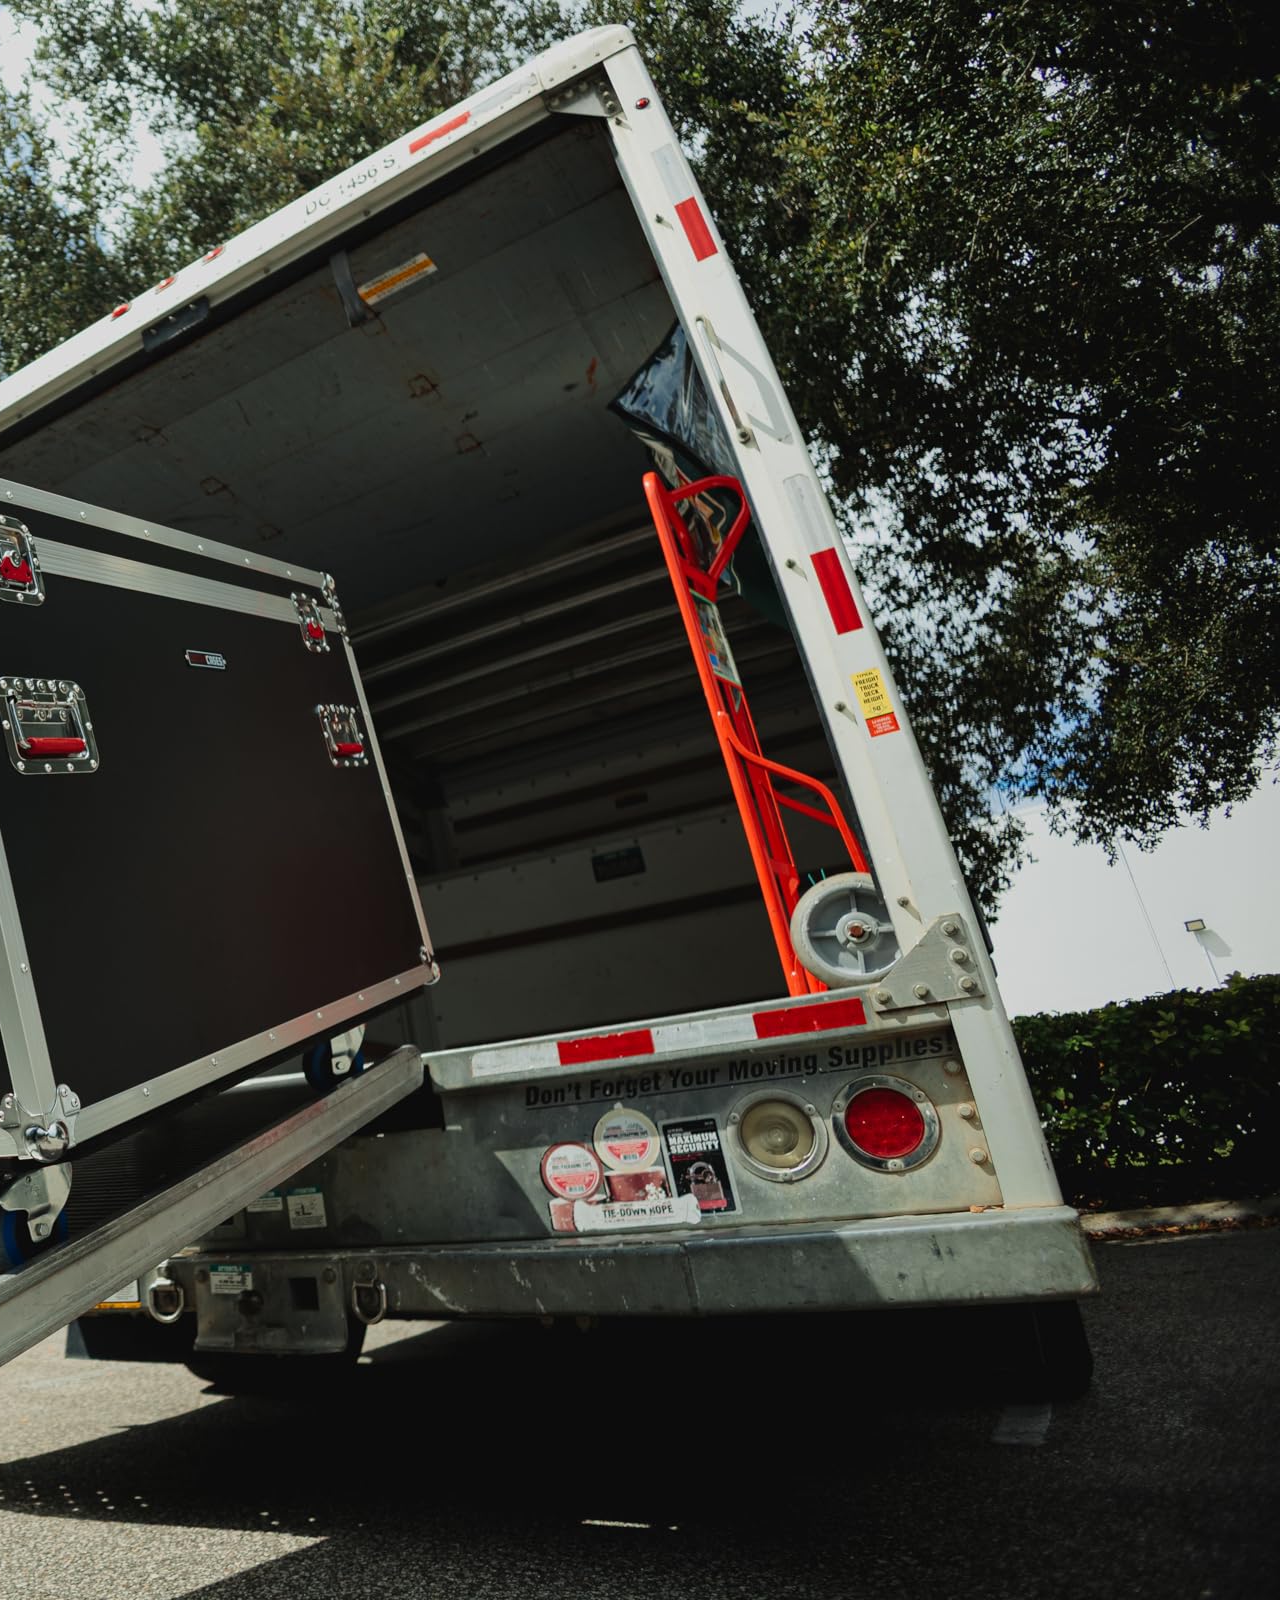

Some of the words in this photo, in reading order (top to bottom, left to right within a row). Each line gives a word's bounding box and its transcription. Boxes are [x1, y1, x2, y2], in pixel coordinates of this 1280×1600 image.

[855, 675, 879, 686] FREIGHT
[860, 682, 879, 692] TRUCK
[863, 689, 880, 698] DECK
[863, 694, 884, 704] HEIGHT
[525, 1082, 581, 1106] Don't
[590, 1071, 662, 1099] Forget
[670, 1065, 721, 1089] Your
[728, 1053, 818, 1082] Moving
[828, 1035, 954, 1068] Supplies!
[669, 1131, 718, 1145] MAXIMUM
[670, 1140, 719, 1154] SECURITY
[602, 1207, 647, 1218] TIE-DOWN
